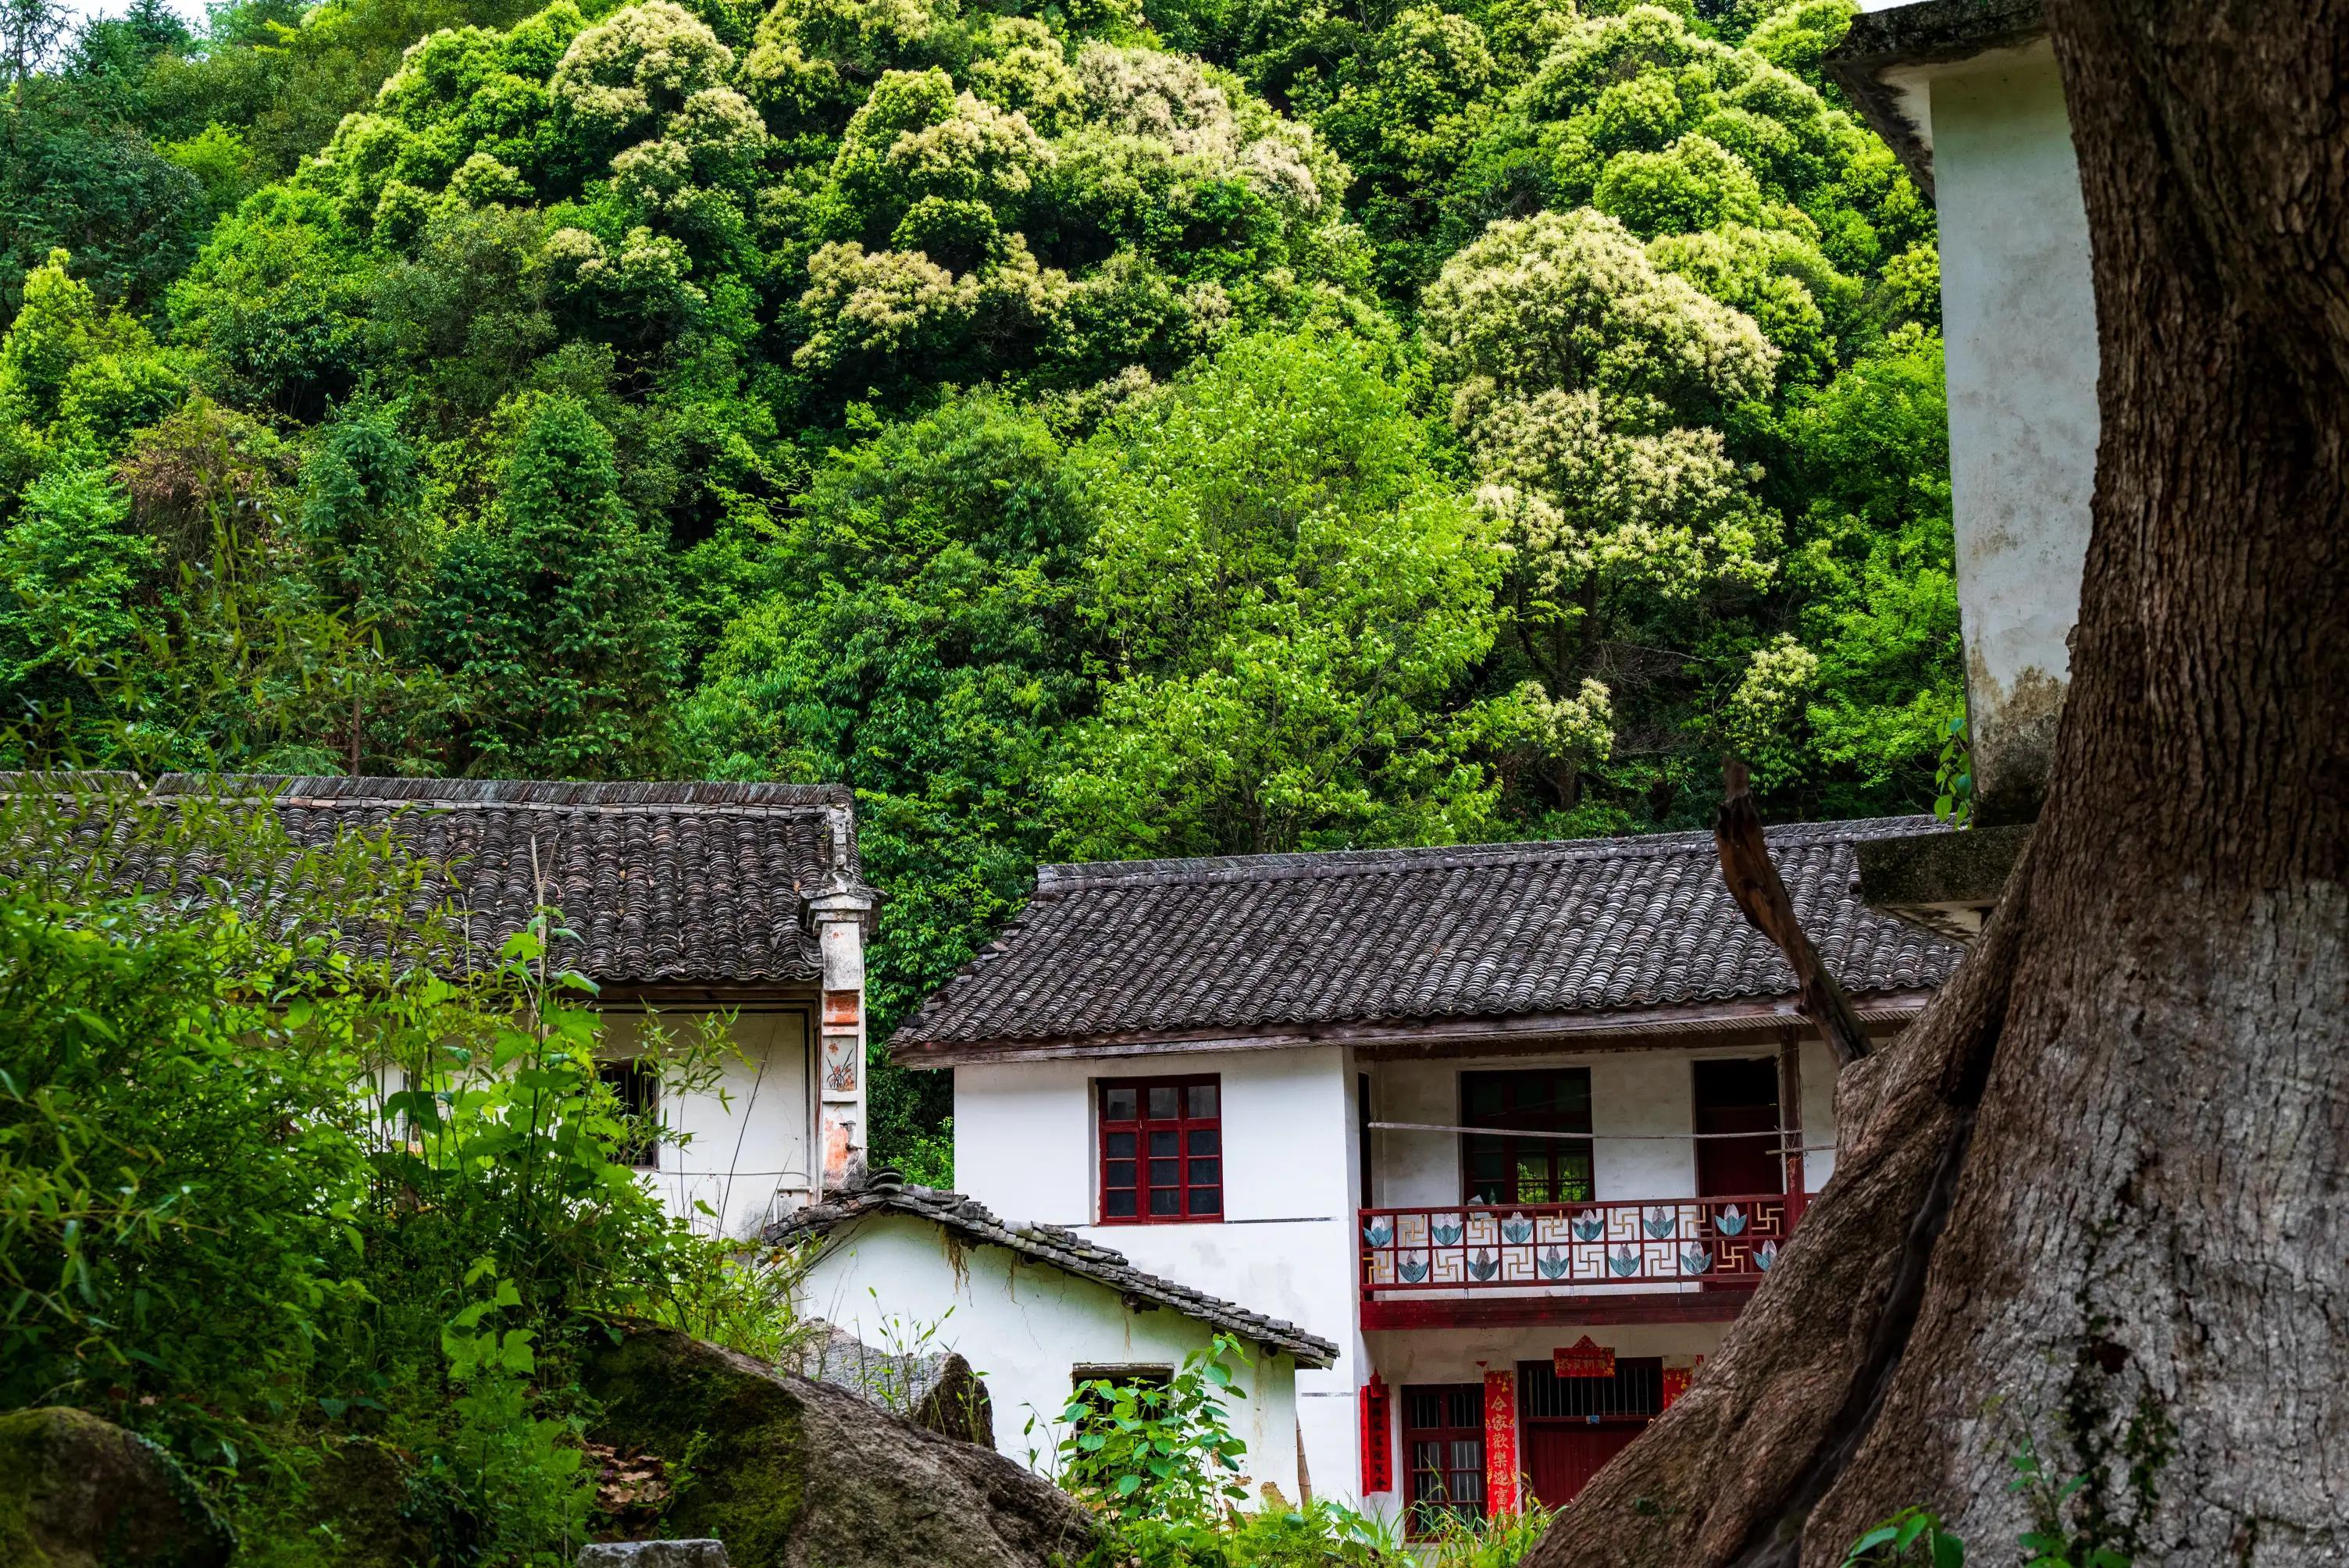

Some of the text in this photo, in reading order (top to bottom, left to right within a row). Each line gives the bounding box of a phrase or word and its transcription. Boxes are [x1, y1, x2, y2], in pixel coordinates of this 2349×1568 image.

[1490, 1395, 1510, 1511] 合家歡樂迎富
